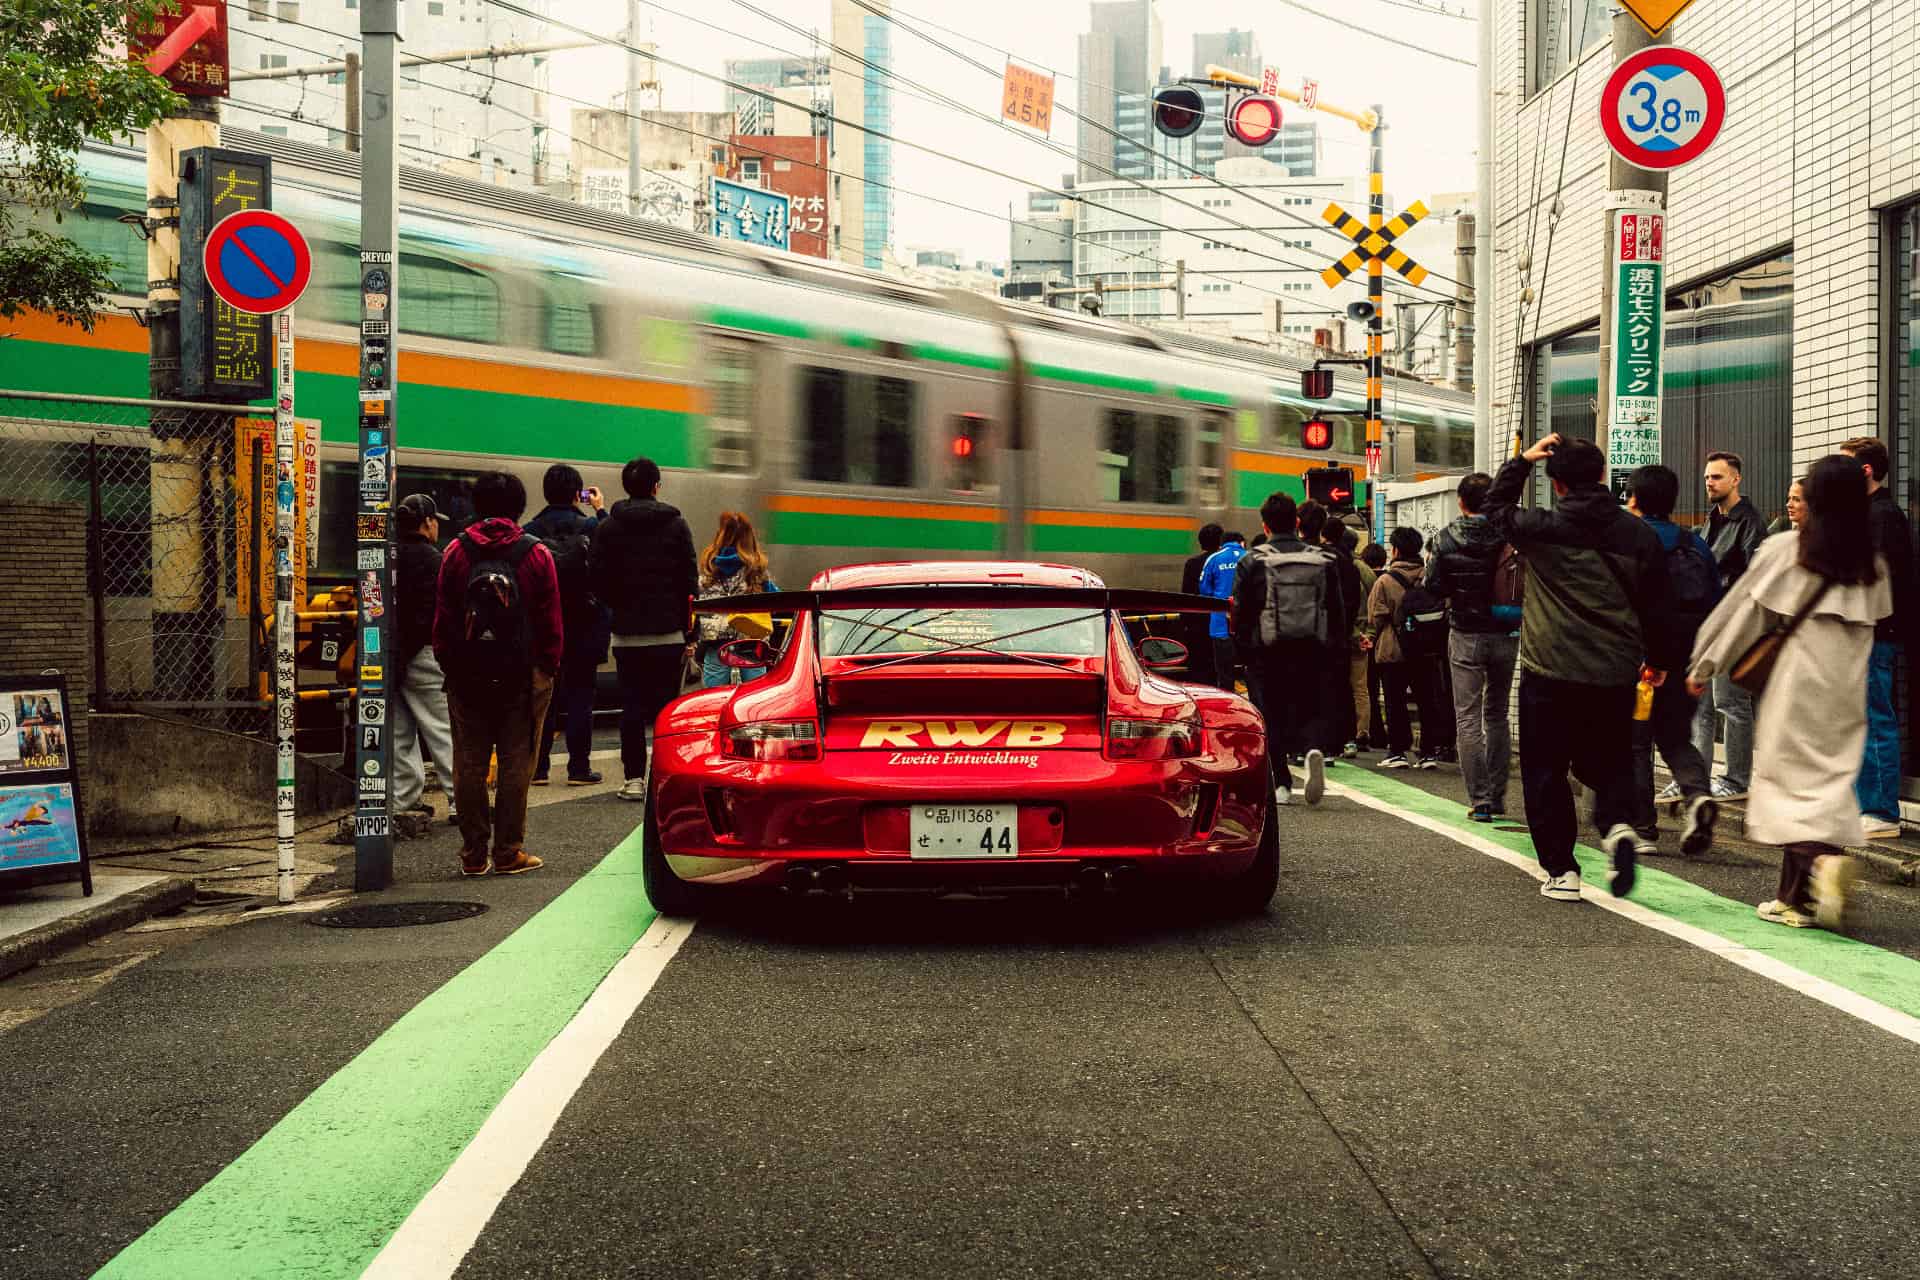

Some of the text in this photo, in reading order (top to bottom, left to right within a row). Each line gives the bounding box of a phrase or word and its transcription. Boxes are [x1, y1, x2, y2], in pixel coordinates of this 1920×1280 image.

[1626, 81, 1700, 134] 3.8m
[860, 721, 1067, 748] RWB
[888, 751, 1040, 769] Zweite Entwicklung
[980, 826, 1012, 854] 44
